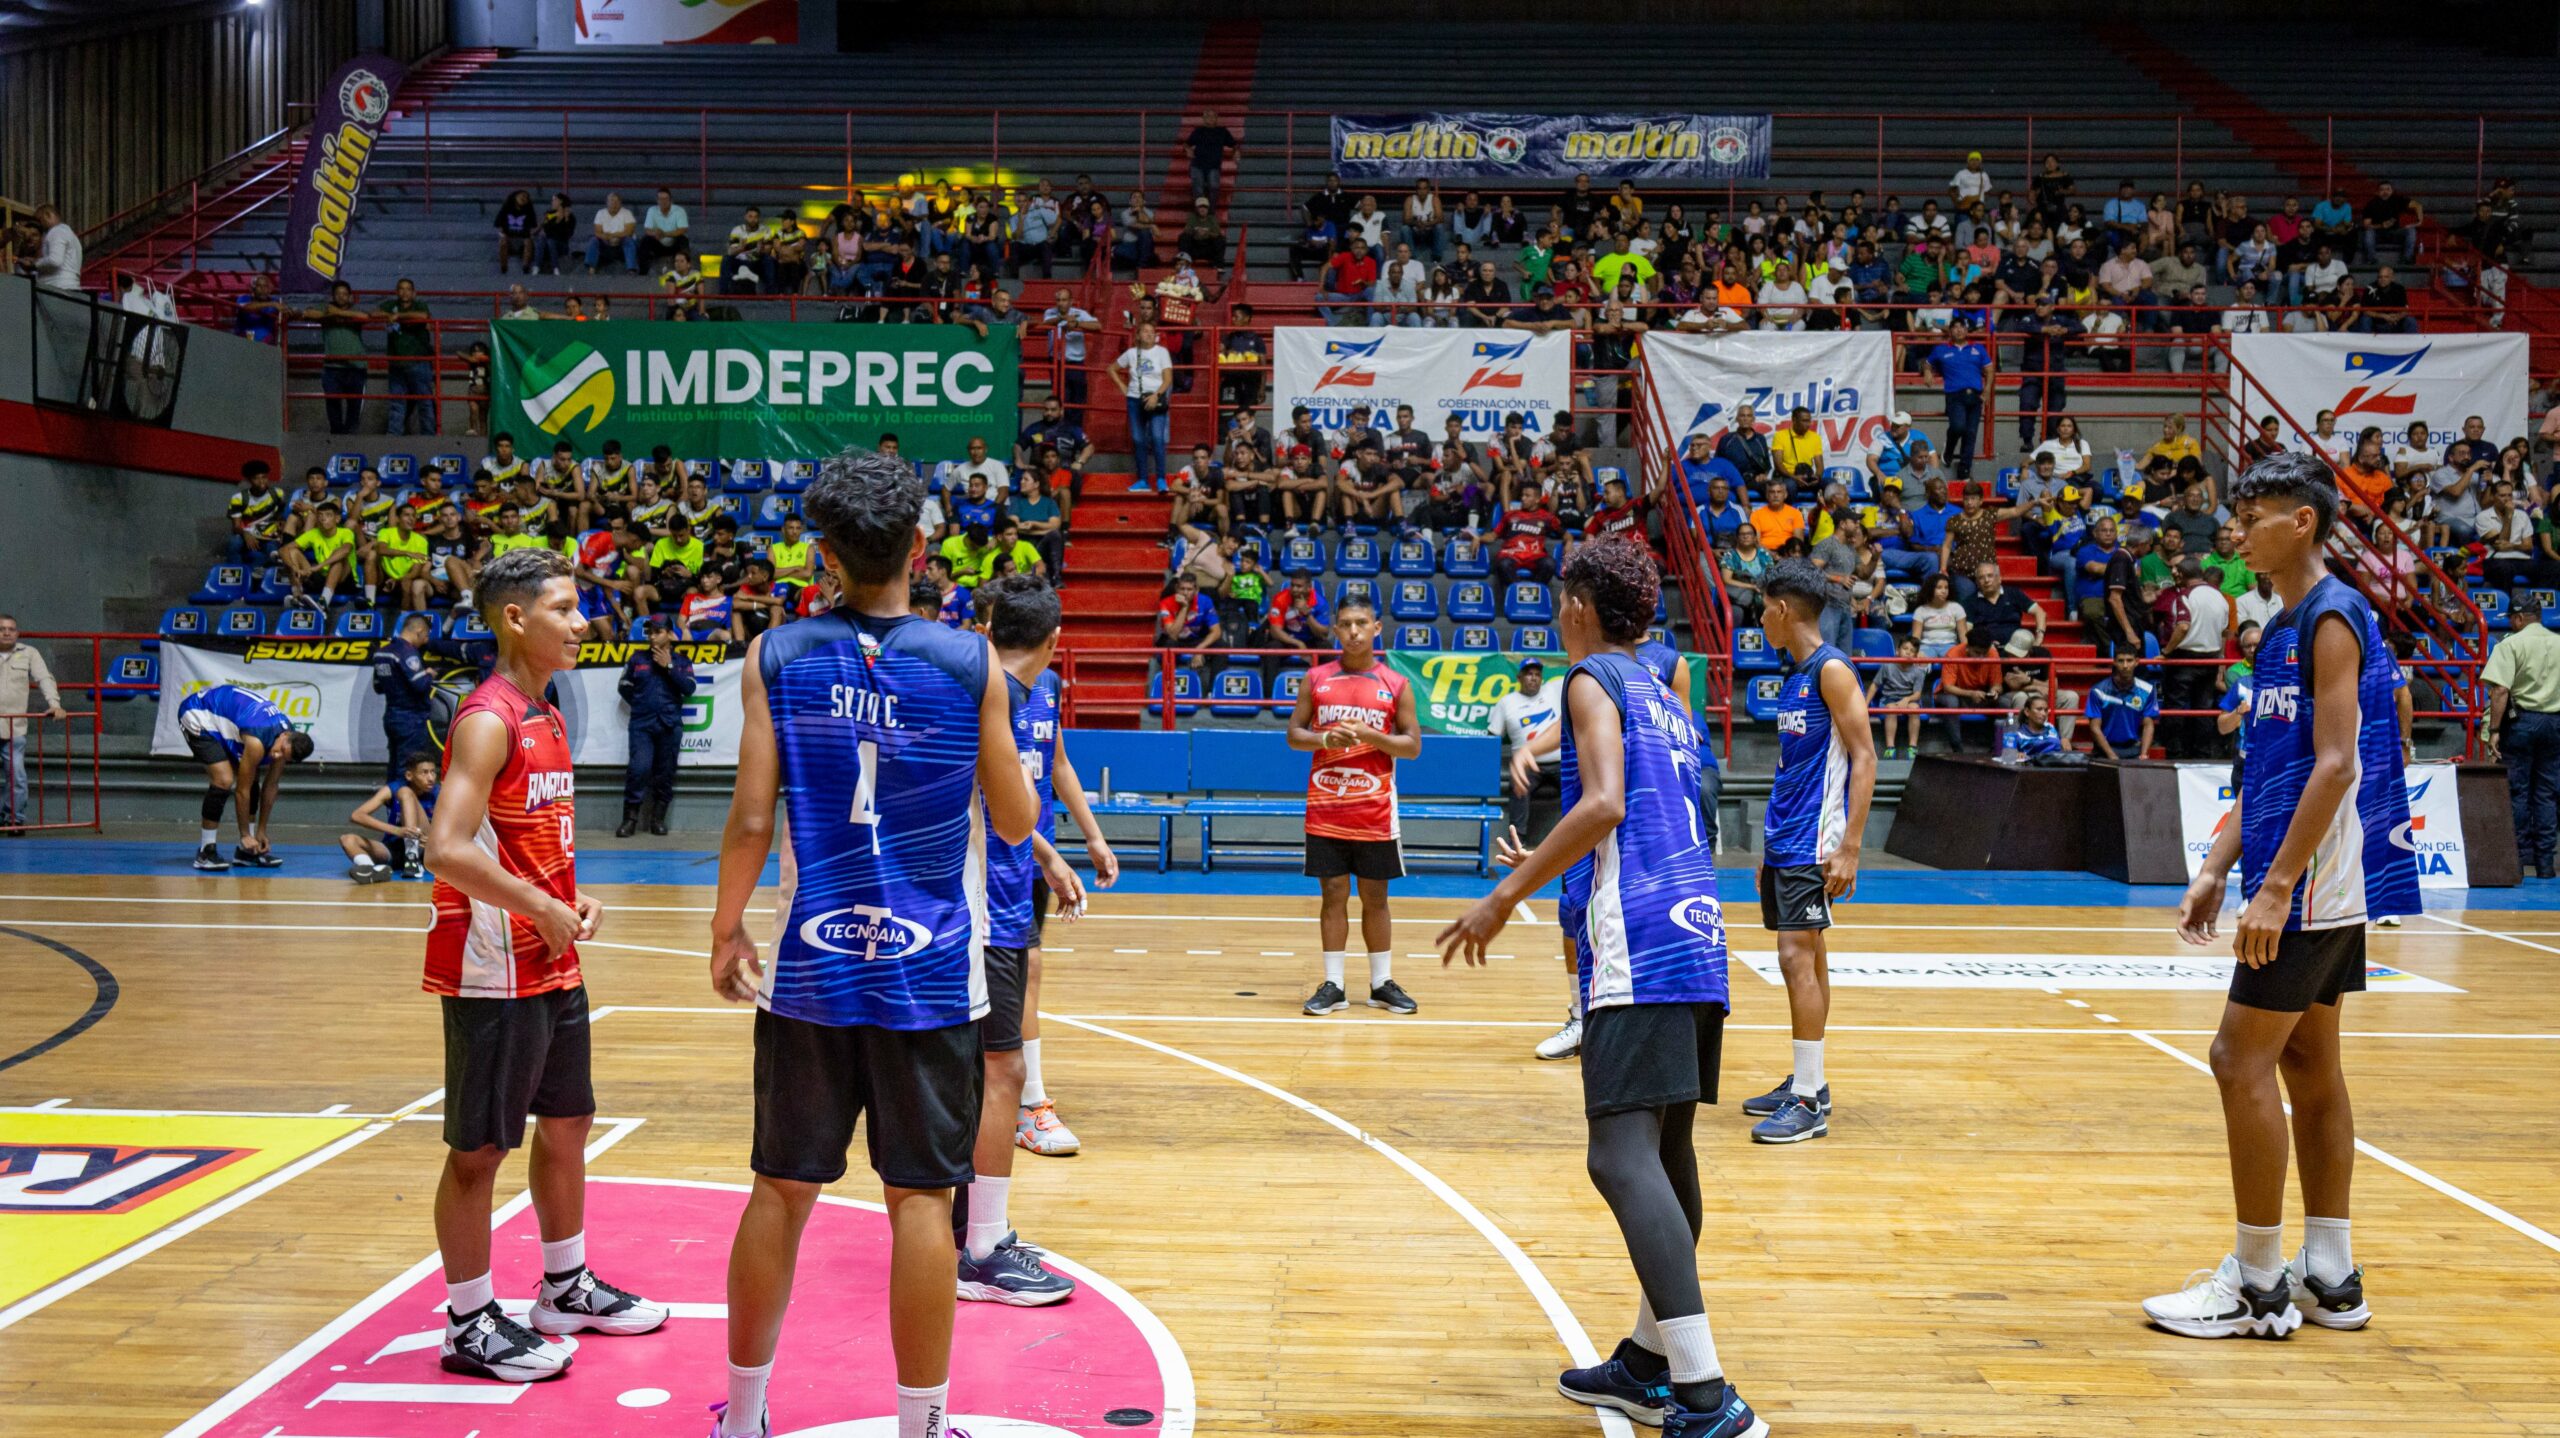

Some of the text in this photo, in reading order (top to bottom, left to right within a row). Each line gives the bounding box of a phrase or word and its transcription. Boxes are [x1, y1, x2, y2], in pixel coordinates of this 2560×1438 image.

[1343, 123, 1480, 161] maltín
[1564, 123, 1701, 161] maltín
[307, 121, 374, 279] maltín
[626, 348, 995, 408] IMDEPREC
[1290, 395, 1378, 408] GOBERNACIÓN
[1437, 397, 1552, 410] GOBERNACIÓN DEL
[1745, 377, 1859, 417] Zulia
[626, 410, 693, 422] Instituto
[804, 410, 868, 425] Deporte
[872, 413, 882, 426] y
[886, 411, 899, 423] la
[904, 410, 994, 423] Recreación
[1308, 408, 1393, 431] ZULA
[1450, 409, 1541, 433] ZULA
[244, 641, 371, 664] ¡SOMOS
[1317, 704, 1389, 731] AMAZONAS
[1319, 773, 1372, 791] TECNOAMA
[849, 740, 882, 856] 4
[2436, 841, 2461, 852] DEL
[1759, 966, 2057, 977] Bolivariao
